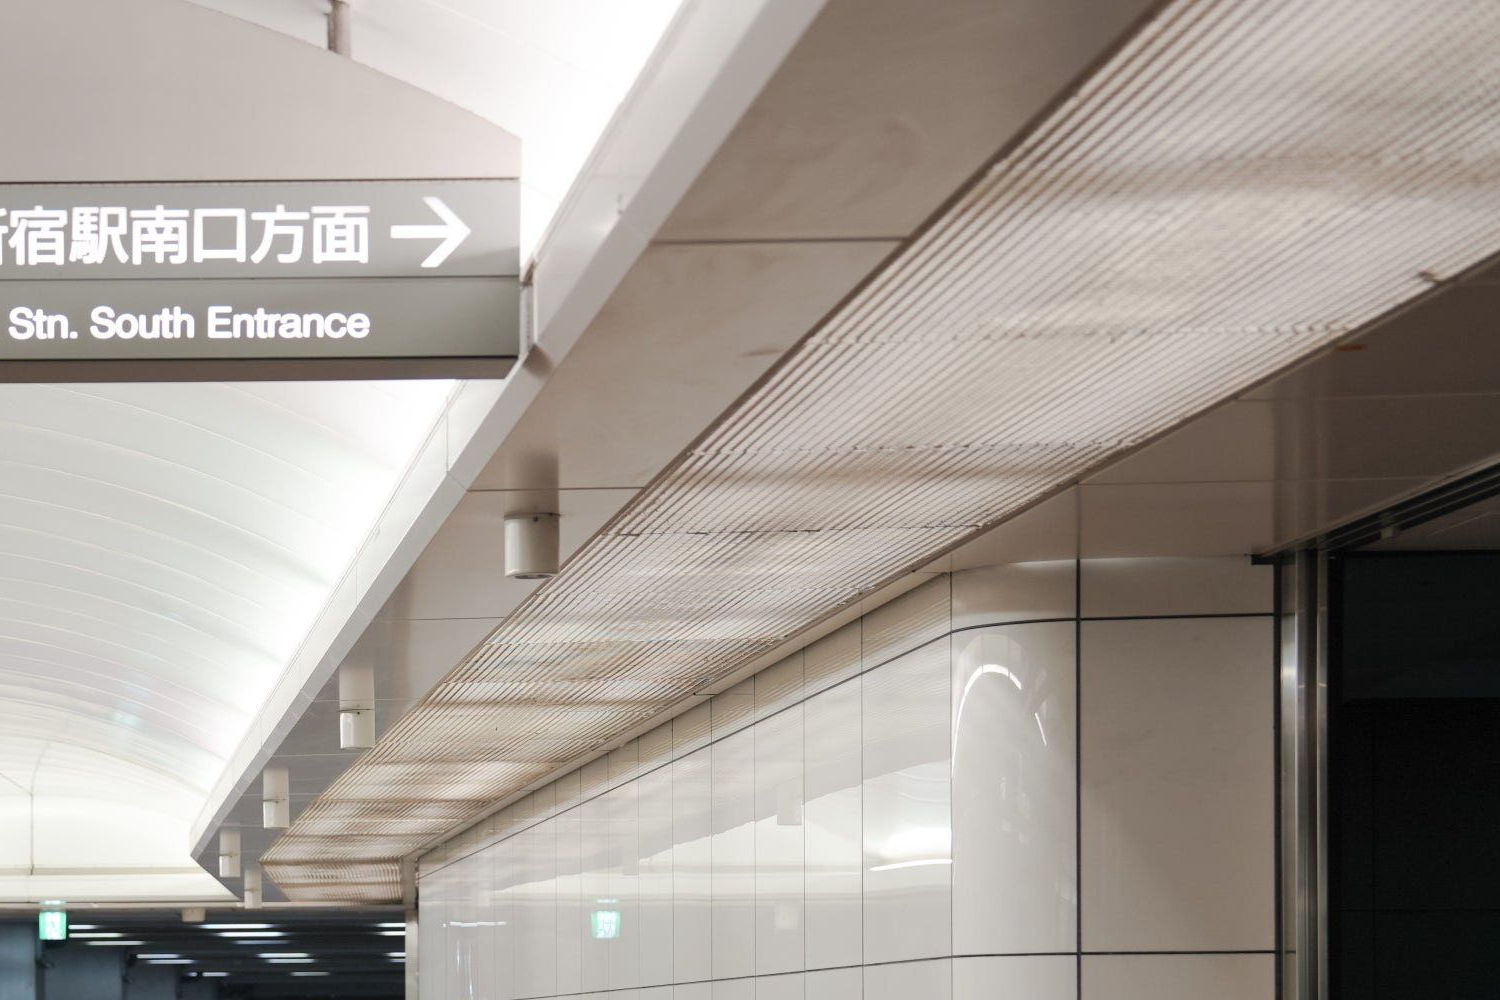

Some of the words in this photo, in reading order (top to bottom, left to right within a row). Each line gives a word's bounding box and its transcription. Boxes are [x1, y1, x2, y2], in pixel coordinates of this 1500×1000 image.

[9, 306, 78, 340] Stn.
[90, 306, 195, 340] South
[208, 306, 371, 339] Entrance
